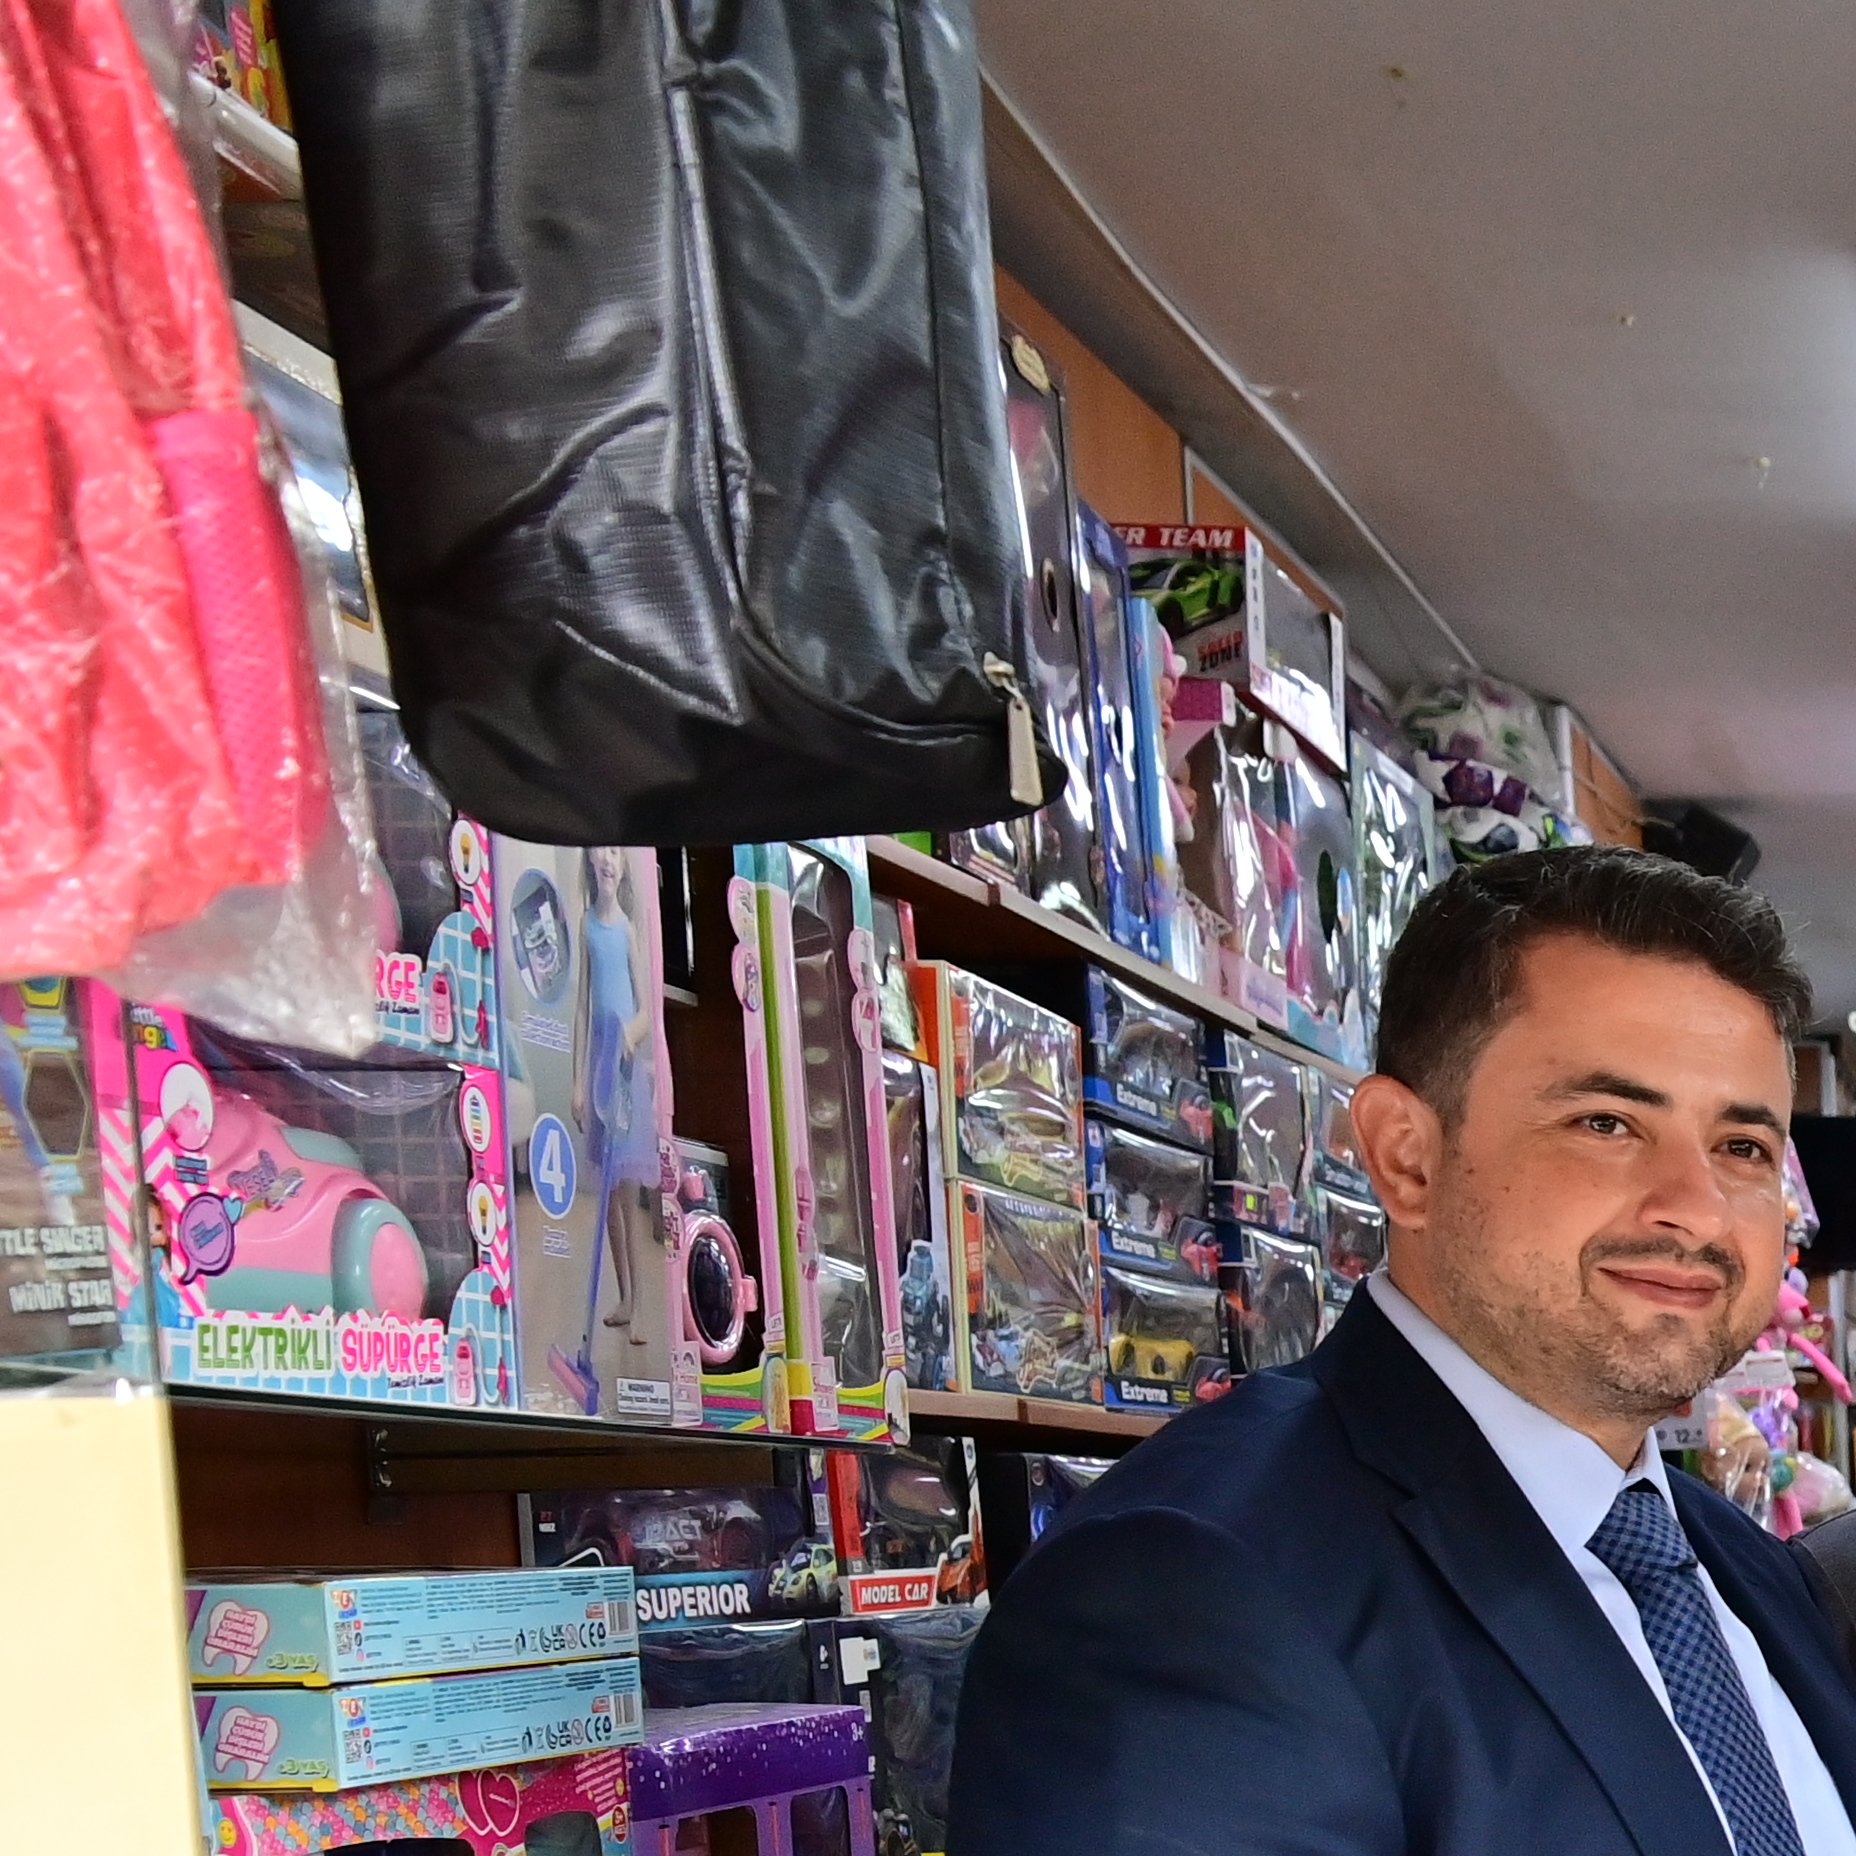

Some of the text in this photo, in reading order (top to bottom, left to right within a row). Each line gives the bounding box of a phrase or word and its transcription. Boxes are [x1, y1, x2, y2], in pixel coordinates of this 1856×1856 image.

[1159, 527, 1235, 549] TEAM
[1115, 1083, 1159, 1118] Extreme
[539, 1128, 567, 1204] 4
[1111, 1230, 1158, 1261] Extreme
[197, 1317, 442, 1374] ELEKTRİKLİ SÜPÜRGE
[1119, 1378, 1170, 1405] Extreme
[636, 1582, 752, 1622] SUPERIOR
[860, 1581, 930, 1606] MODEL CAR
[851, 1721, 865, 1742] 3+
